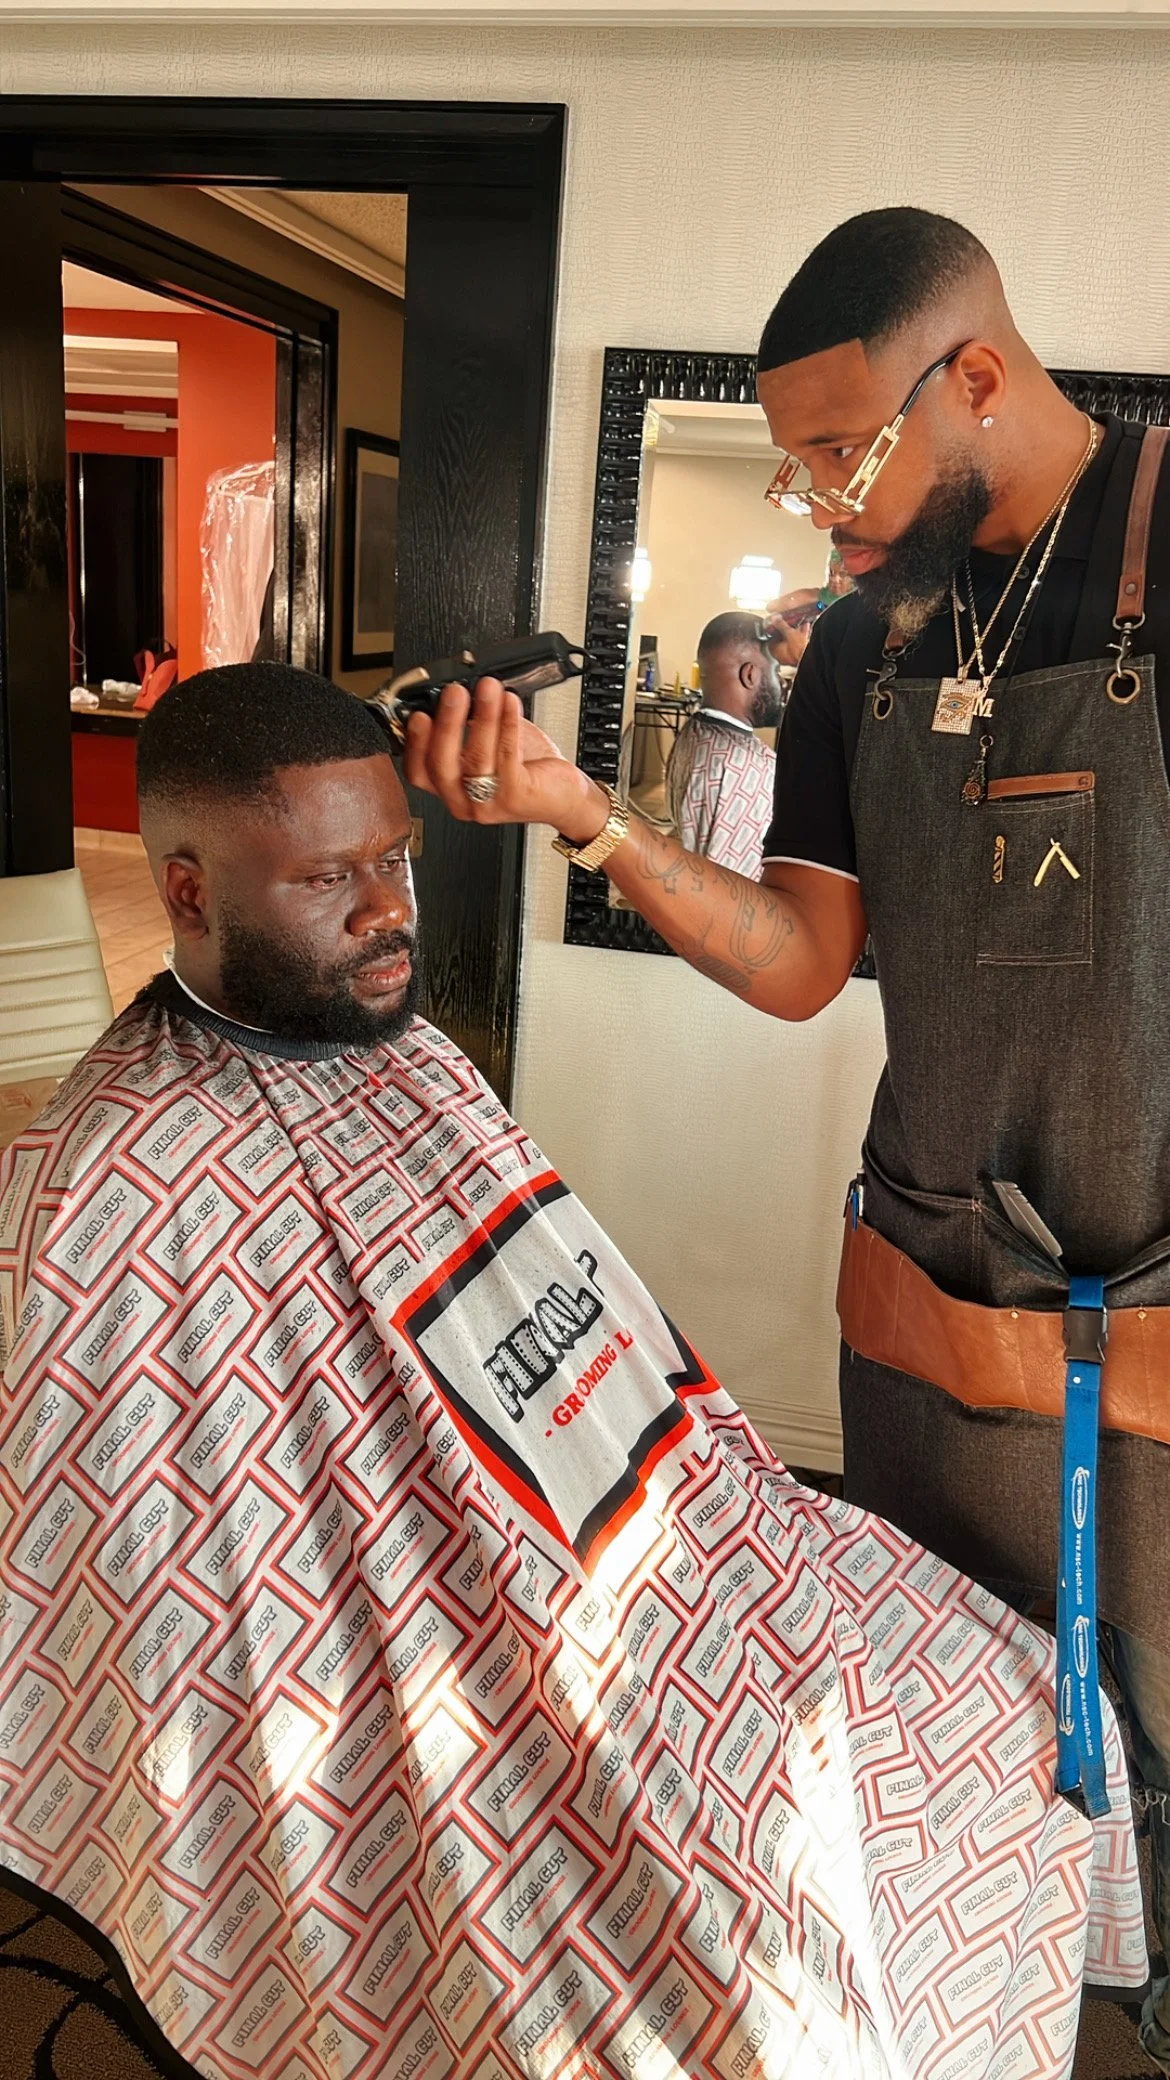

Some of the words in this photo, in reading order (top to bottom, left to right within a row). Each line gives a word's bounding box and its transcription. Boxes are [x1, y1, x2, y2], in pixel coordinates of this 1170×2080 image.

[148, 1124, 184, 1160] FINAL
[179, 1106, 202, 1130] CUT
[238, 1142, 270, 1173] FINAL
[266, 1130, 283, 1150] CUT
[350, 1196, 379, 1221] FINAL
[376, 1181, 395, 1202] CUT
[66, 1219, 104, 1264] FINAL
[99, 1188, 126, 1221] CUT
[163, 1216, 200, 1260] FINAL
[194, 1192, 219, 1221] CUT
[250, 1226, 282, 1267] FINAL
[279, 1210, 301, 1239] CUT
[21, 1294, 43, 1326] CUT
[81, 1320, 118, 1365] FINAL
[114, 1289, 141, 1321] CUT
[177, 1318, 212, 1364] FINAL
[208, 1290, 233, 1321] CUT
[264, 1325, 298, 1367] FINAL
[294, 1300, 317, 1326] CUT
[345, 1344, 377, 1378] FINAL
[483, 1282, 603, 1423] FINAL
[552, 1343, 617, 1426] GROMING
[10, 1426, 38, 1468] FINAL
[35, 1395, 60, 1428] CUT
[92, 1426, 131, 1470] FINAL
[126, 1393, 155, 1426] CUT
[189, 1424, 228, 1468] FINAL
[223, 1394, 246, 1424] CUT
[280, 1423, 312, 1468] FINAL
[309, 1396, 329, 1427] CUT
[360, 1439, 388, 1475] FINAL
[386, 1412, 410, 1441] CUT
[437, 1428, 457, 1454] CUT
[25, 1528, 57, 1568] FINAL
[50, 1499, 74, 1528] CUT
[693, 1492, 728, 1528] FINAL
[107, 1532, 144, 1576] FINAL
[140, 1499, 169, 1533] CUT
[206, 1530, 243, 1576] FINAL
[238, 1500, 260, 1531] CUT
[298, 1529, 332, 1572] FINAL
[371, 1538, 405, 1580] FINAL
[400, 1512, 424, 1542] CUT
[459, 1558, 483, 1590] FIN
[729, 1561, 754, 1590] CUT
[1075, 1533, 1084, 1605] www.nsc-tech.com
[58, 1624, 80, 1660] FINAL
[77, 1600, 94, 1628] CUT
[252, 1606, 276, 1640] CUT
[316, 1632, 353, 1681] FINAL
[349, 1599, 372, 1633] CUT
[414, 1618, 438, 1648] CUT
[886, 1603, 906, 1628] CUT
[128, 1634, 161, 1680] FINAL
[156, 1608, 182, 1637] CUT
[696, 1636, 724, 1677] FINAL
[936, 1634, 961, 1665] FINAL
[24, 1684, 45, 1712] CUT
[475, 1650, 512, 1698] FINAL
[898, 1681, 920, 1704] CUT
[82, 1717, 111, 1754] FINAL
[105, 1696, 122, 1720] CUT
[182, 1705, 208, 1736] CUT
[792, 1688, 826, 1725] FINAL
[932, 1714, 965, 1744] FINAL
[962, 1696, 986, 1718] CUT
[1080, 1681, 1094, 1756] www.nsc-tech.com
[330, 1738, 368, 1783] FINAL
[365, 1705, 394, 1740] CUT
[722, 1732, 746, 1777] FINAL
[741, 1709, 762, 1736] CUT
[868, 1726, 892, 1743] CUT
[1000, 1730, 1031, 1760] FINAL
[487, 1765, 528, 1812] FINAL
[522, 1731, 551, 1766] CUT
[600, 1746, 623, 1782] CUT
[656, 1768, 681, 1805] CUT
[28, 1800, 56, 1834] FINAL
[52, 1775, 72, 1804] CUT
[768, 1809, 790, 1842] CUT
[931, 1794, 961, 1829] FINAL
[958, 1777, 980, 1801] CUT
[977, 1804, 1009, 1833] FINAL
[1008, 1789, 1032, 1811] CUT
[179, 1824, 214, 1868] FINAL
[210, 1796, 236, 1829] CUT
[281, 1820, 309, 1853] CUT
[347, 1840, 384, 1888] FINAL
[380, 1812, 406, 1842] CUT
[886, 1838, 912, 1852] CUT
[66, 1877, 90, 1906] INAL
[87, 1856, 105, 1883] CUT
[437, 1843, 464, 1876] CUT
[501, 1882, 543, 1932] FINAL
[538, 1847, 568, 1884] CUT
[606, 1890, 643, 1938] FINAL
[962, 1884, 995, 1915] FINAL
[993, 1872, 1018, 1894] CUT
[1037, 1885, 1059, 1906] CUT
[206, 1916, 241, 1959] FINAL
[236, 1888, 260, 1921] CUT
[298, 1926, 325, 1958] CUT
[700, 1920, 719, 1952] FIN
[763, 1926, 781, 1968] FIN
[363, 1943, 398, 1996] FINAL
[394, 1921, 412, 1952] CUT
[458, 1962, 478, 1991] CUT
[896, 1950, 921, 1982] FINAL
[919, 1929, 938, 1952] CUT
[948, 1970, 980, 2000] FINAL
[980, 1955, 1004, 1977] CUT
[1017, 1964, 1040, 1987] CUT
[232, 2004, 267, 2048] FINAL
[261, 1980, 285, 2010] CUT
[515, 2007, 558, 2057] FINAL
[554, 1970, 582, 2009] CUT
[623, 2014, 664, 2068] FINAL
[660, 1978, 688, 2016] CUT
[396, 2050, 421, 2080] INAL
[415, 2026, 438, 2055] CUT
[730, 2028, 763, 2077] FINAL
[967, 2039, 988, 2062] CUT
[1005, 2044, 1023, 2066] CUT
